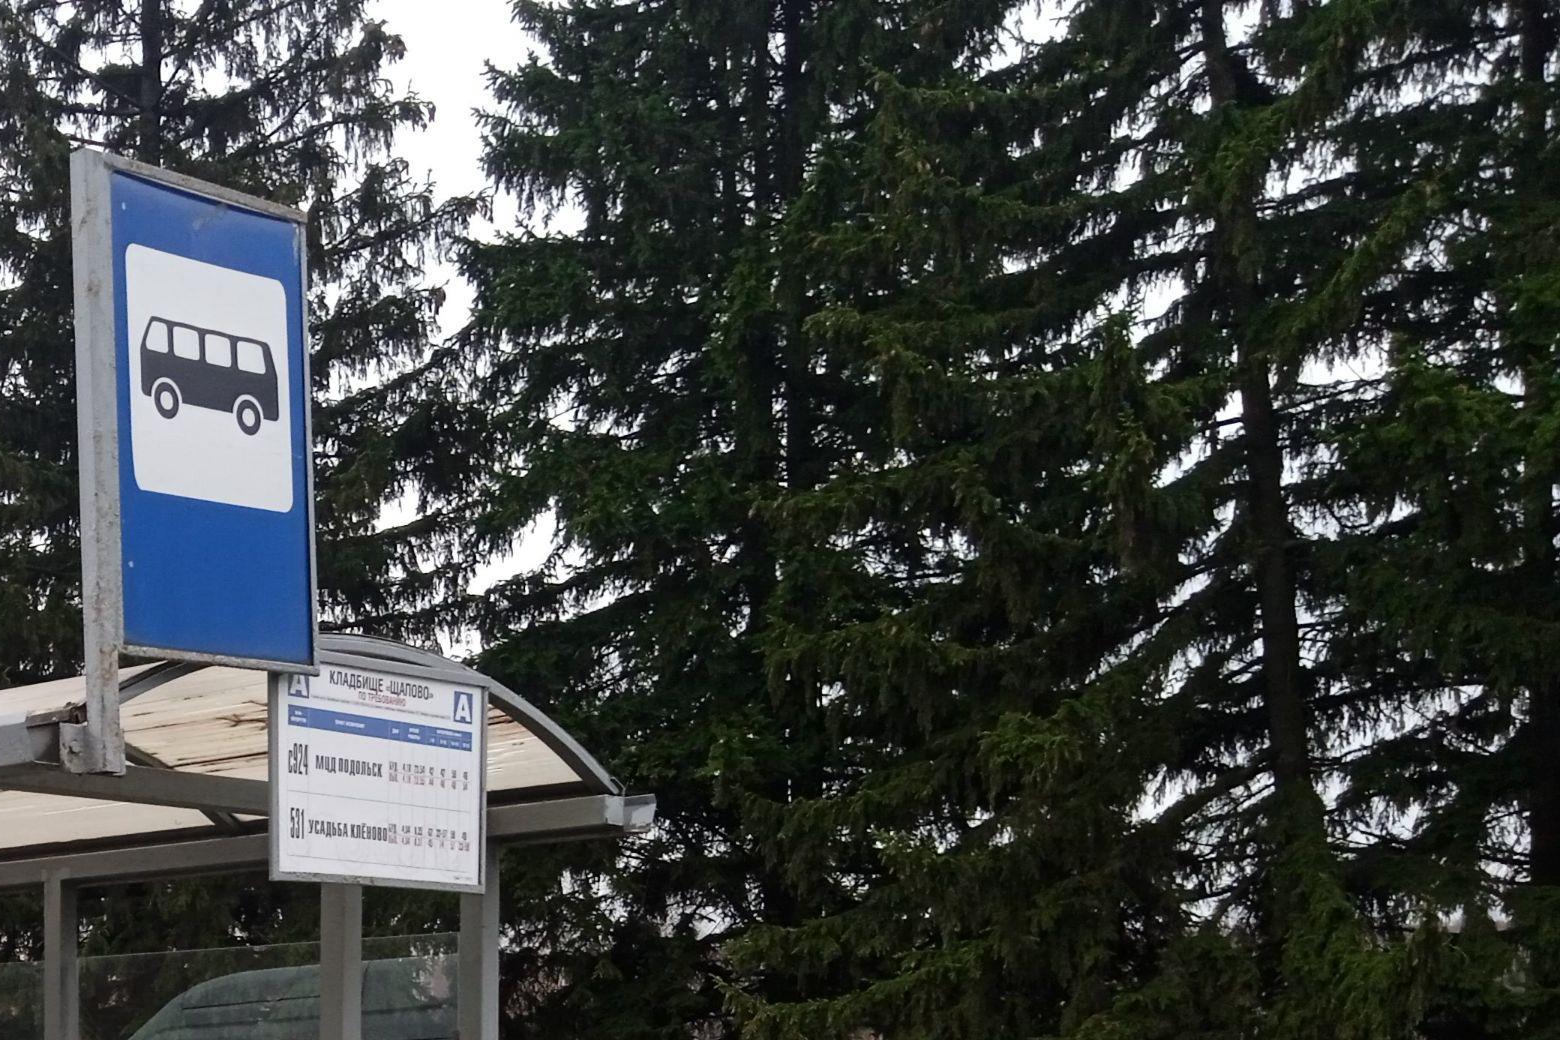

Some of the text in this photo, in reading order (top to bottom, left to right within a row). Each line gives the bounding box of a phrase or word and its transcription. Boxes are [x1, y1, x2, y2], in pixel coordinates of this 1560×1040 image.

[329, 670, 384, 695] КЛАДБИЩЕ
[315, 755, 336, 773] МЦД
[338, 757, 383, 778] ПОДОЛЬСК
[290, 807, 304, 839] 531
[308, 819, 348, 838] УСАДЬБА
[350, 822, 388, 842] КЛЁНОВО
